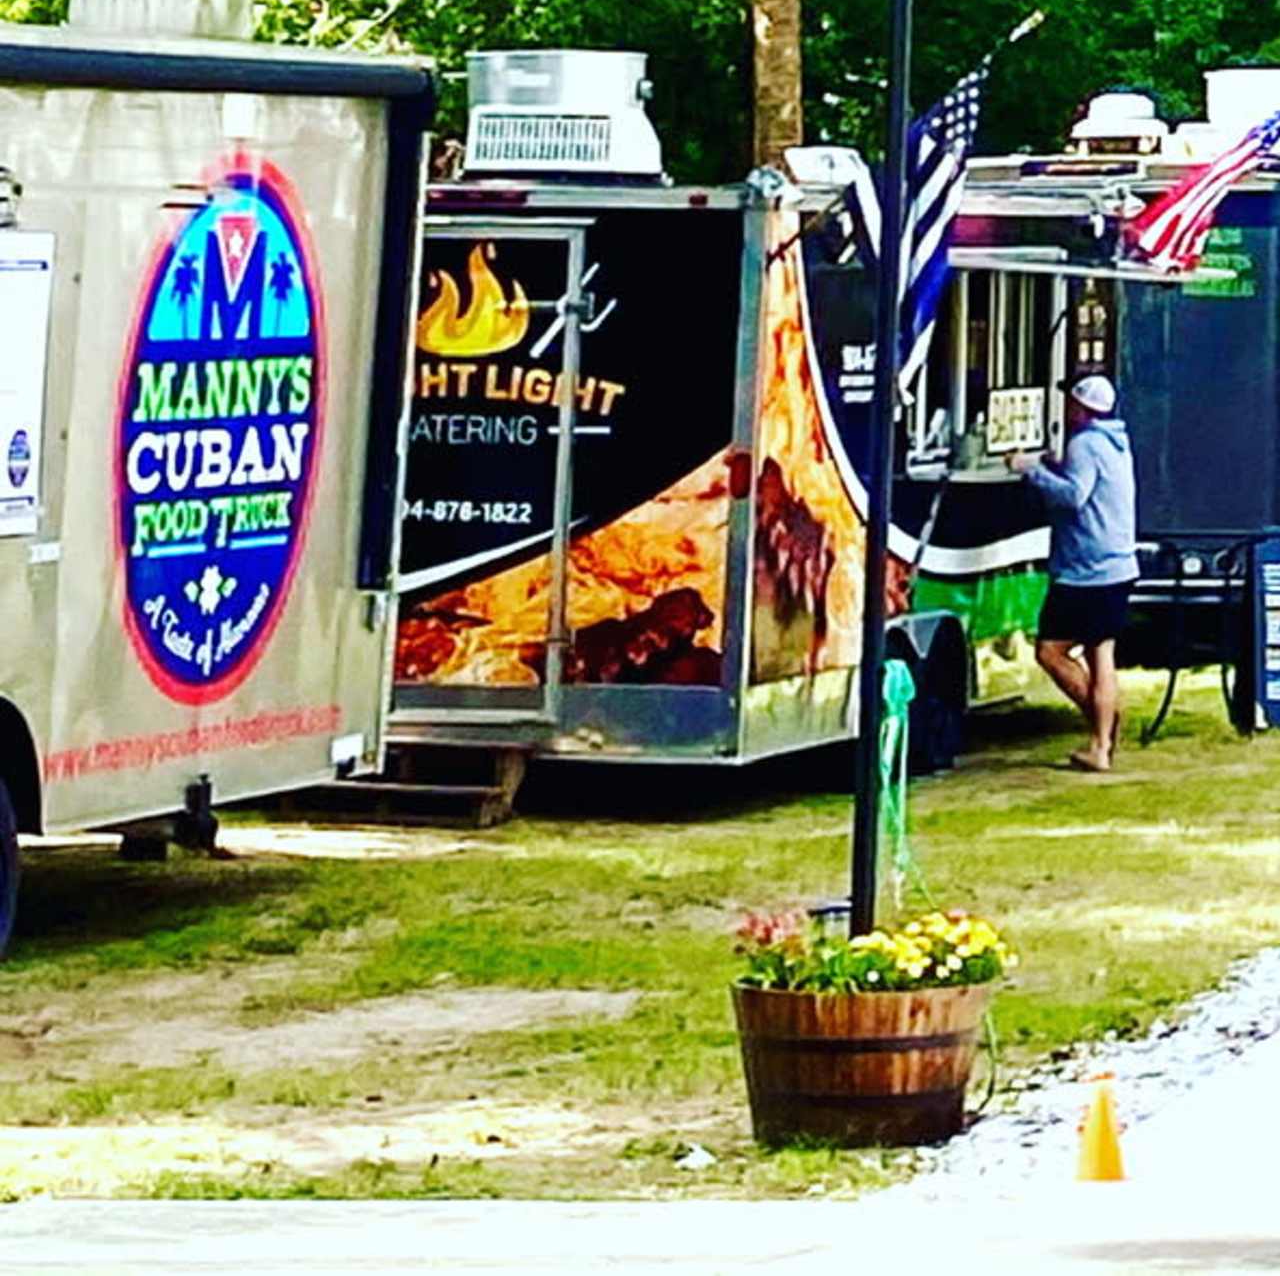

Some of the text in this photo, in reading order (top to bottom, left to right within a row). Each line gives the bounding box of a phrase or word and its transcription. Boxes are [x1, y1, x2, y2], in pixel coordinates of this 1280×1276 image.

[132, 354, 313, 423] MANNYS
[484, 365, 626, 416] LIGHT
[126, 422, 310, 494] CUBAN
[409, 414, 538, 445] ATERING
[131, 492, 293, 557] FOOD TRUCK
